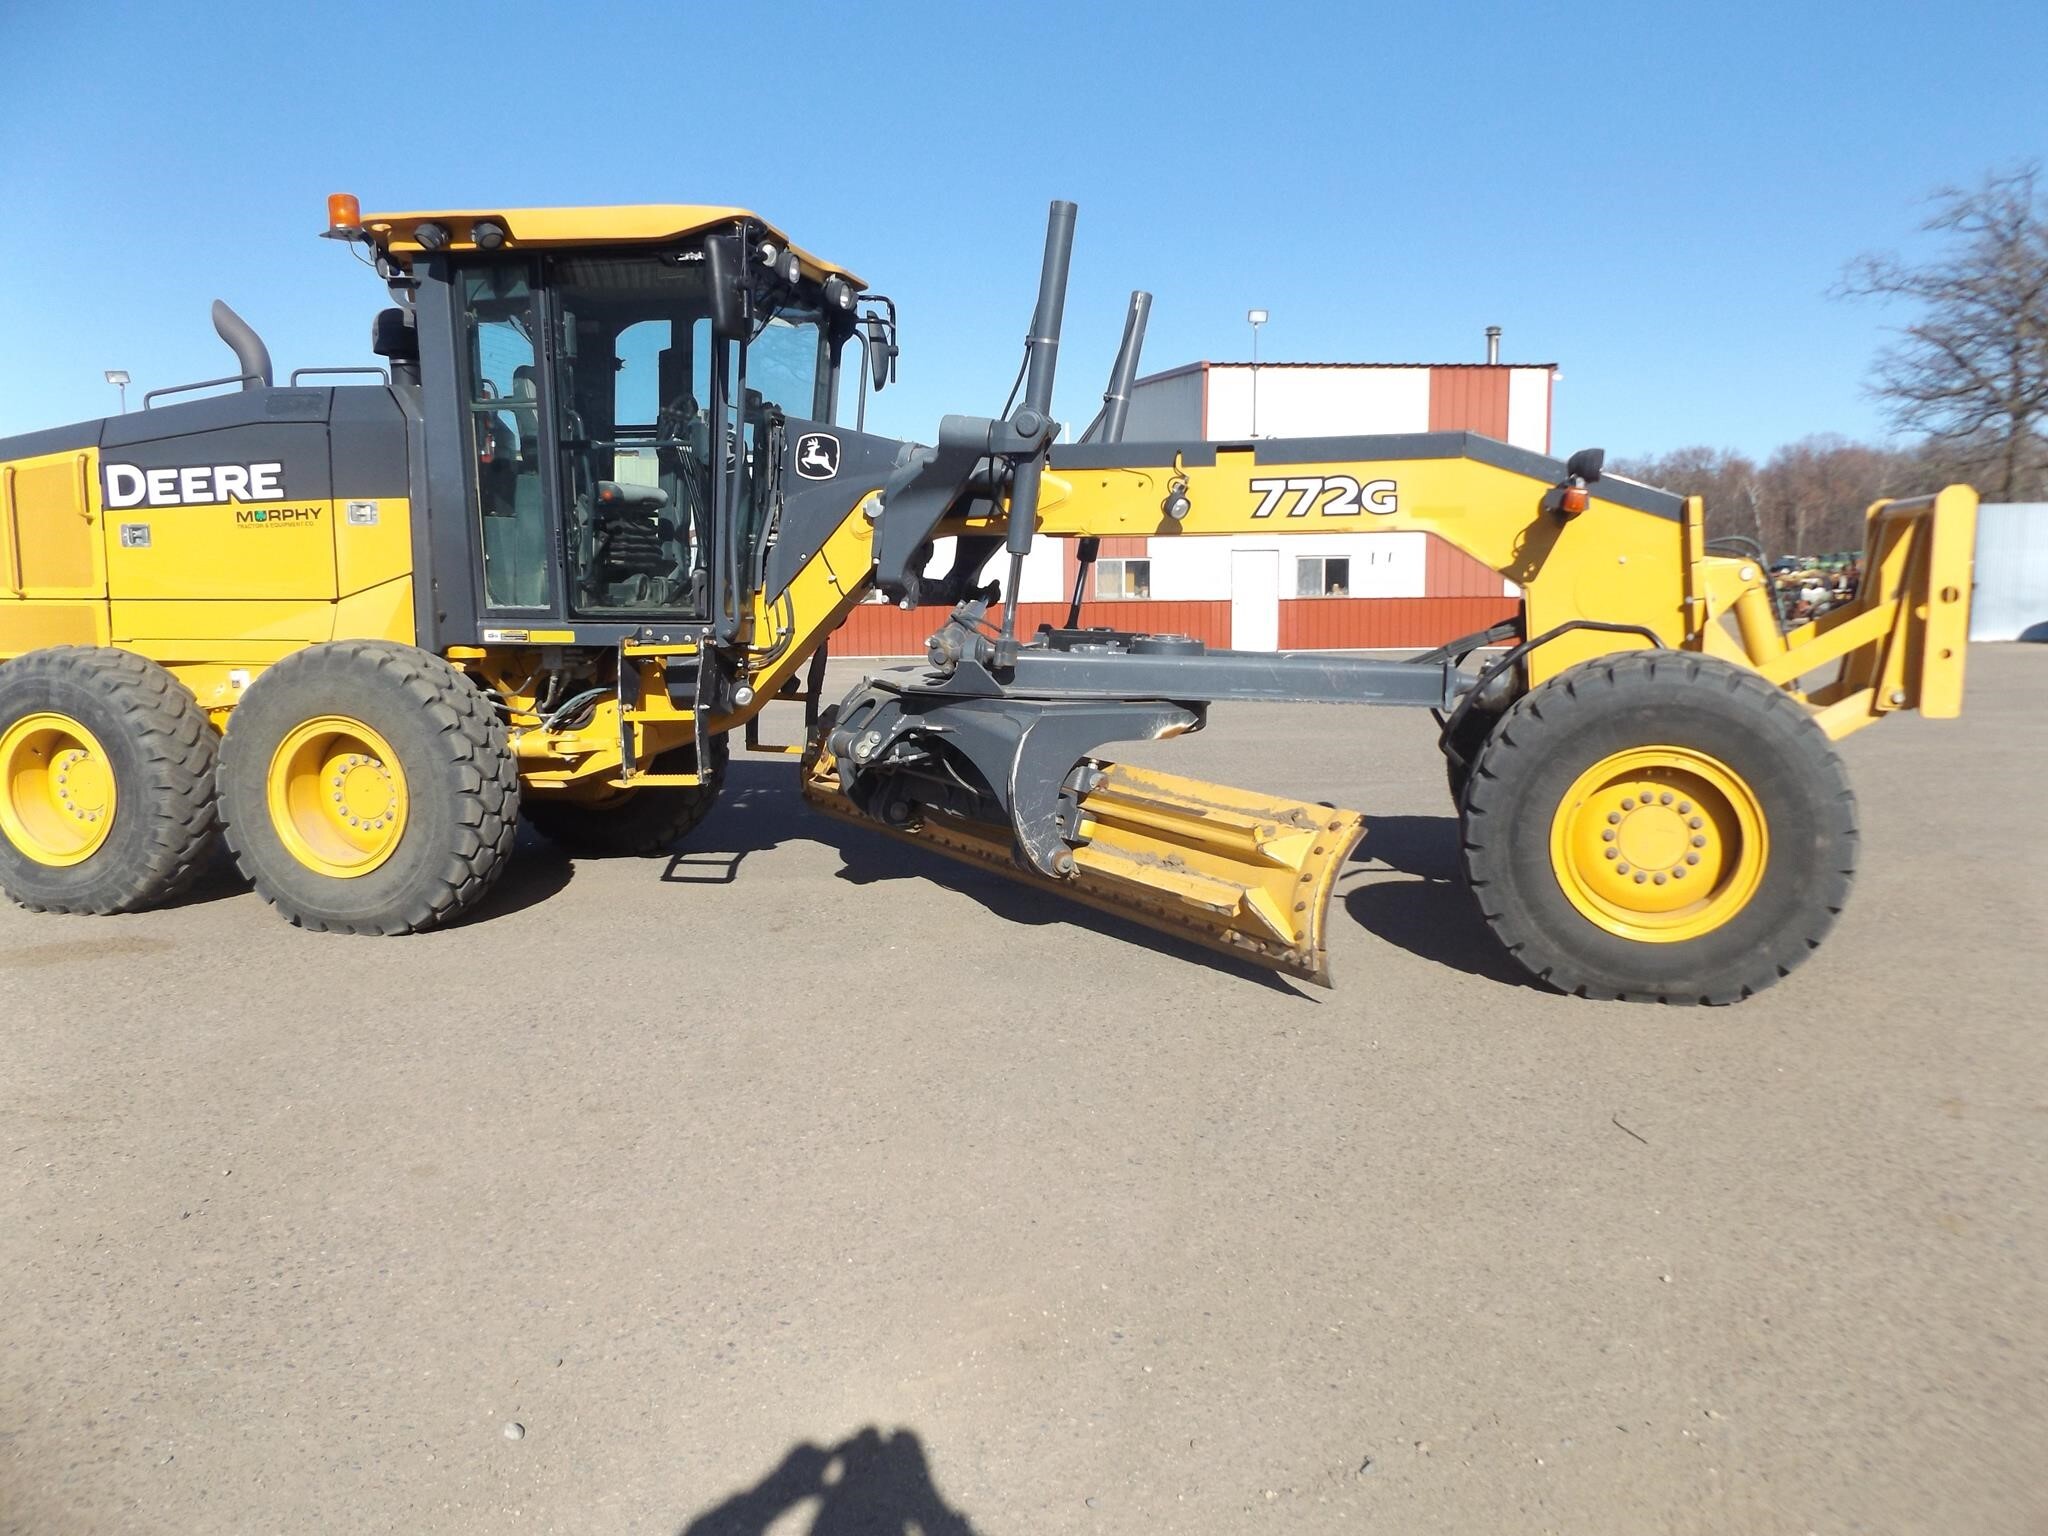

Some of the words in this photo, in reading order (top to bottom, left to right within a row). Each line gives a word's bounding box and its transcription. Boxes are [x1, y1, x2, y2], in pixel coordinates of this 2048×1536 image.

[105, 463, 284, 507] DEERE
[1250, 475, 1398, 518] 772G
[236, 507, 322, 523] MURPHY
